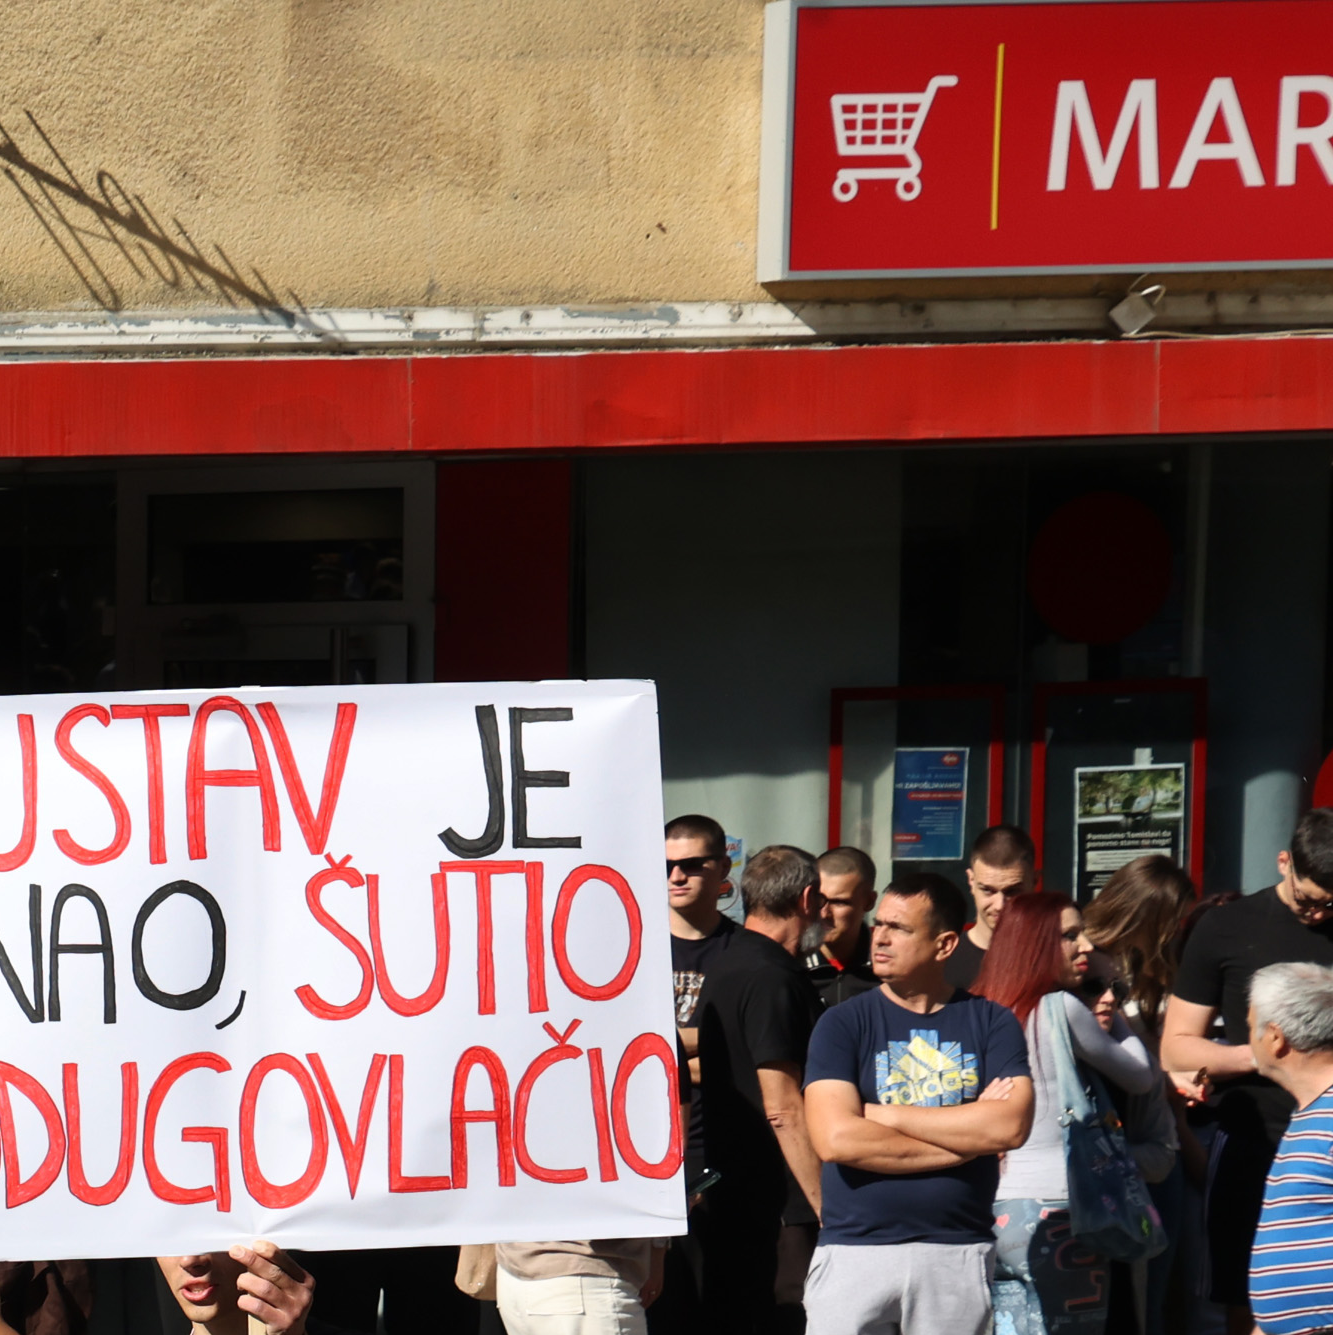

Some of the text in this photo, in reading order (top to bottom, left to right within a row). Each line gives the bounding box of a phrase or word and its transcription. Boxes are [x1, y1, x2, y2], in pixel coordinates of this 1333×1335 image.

[1046, 74, 1333, 191] MAR
[438, 704, 582, 858] JE
[294, 852, 642, 1021] ŠUTIO
[879, 1067, 979, 1106] adidas
